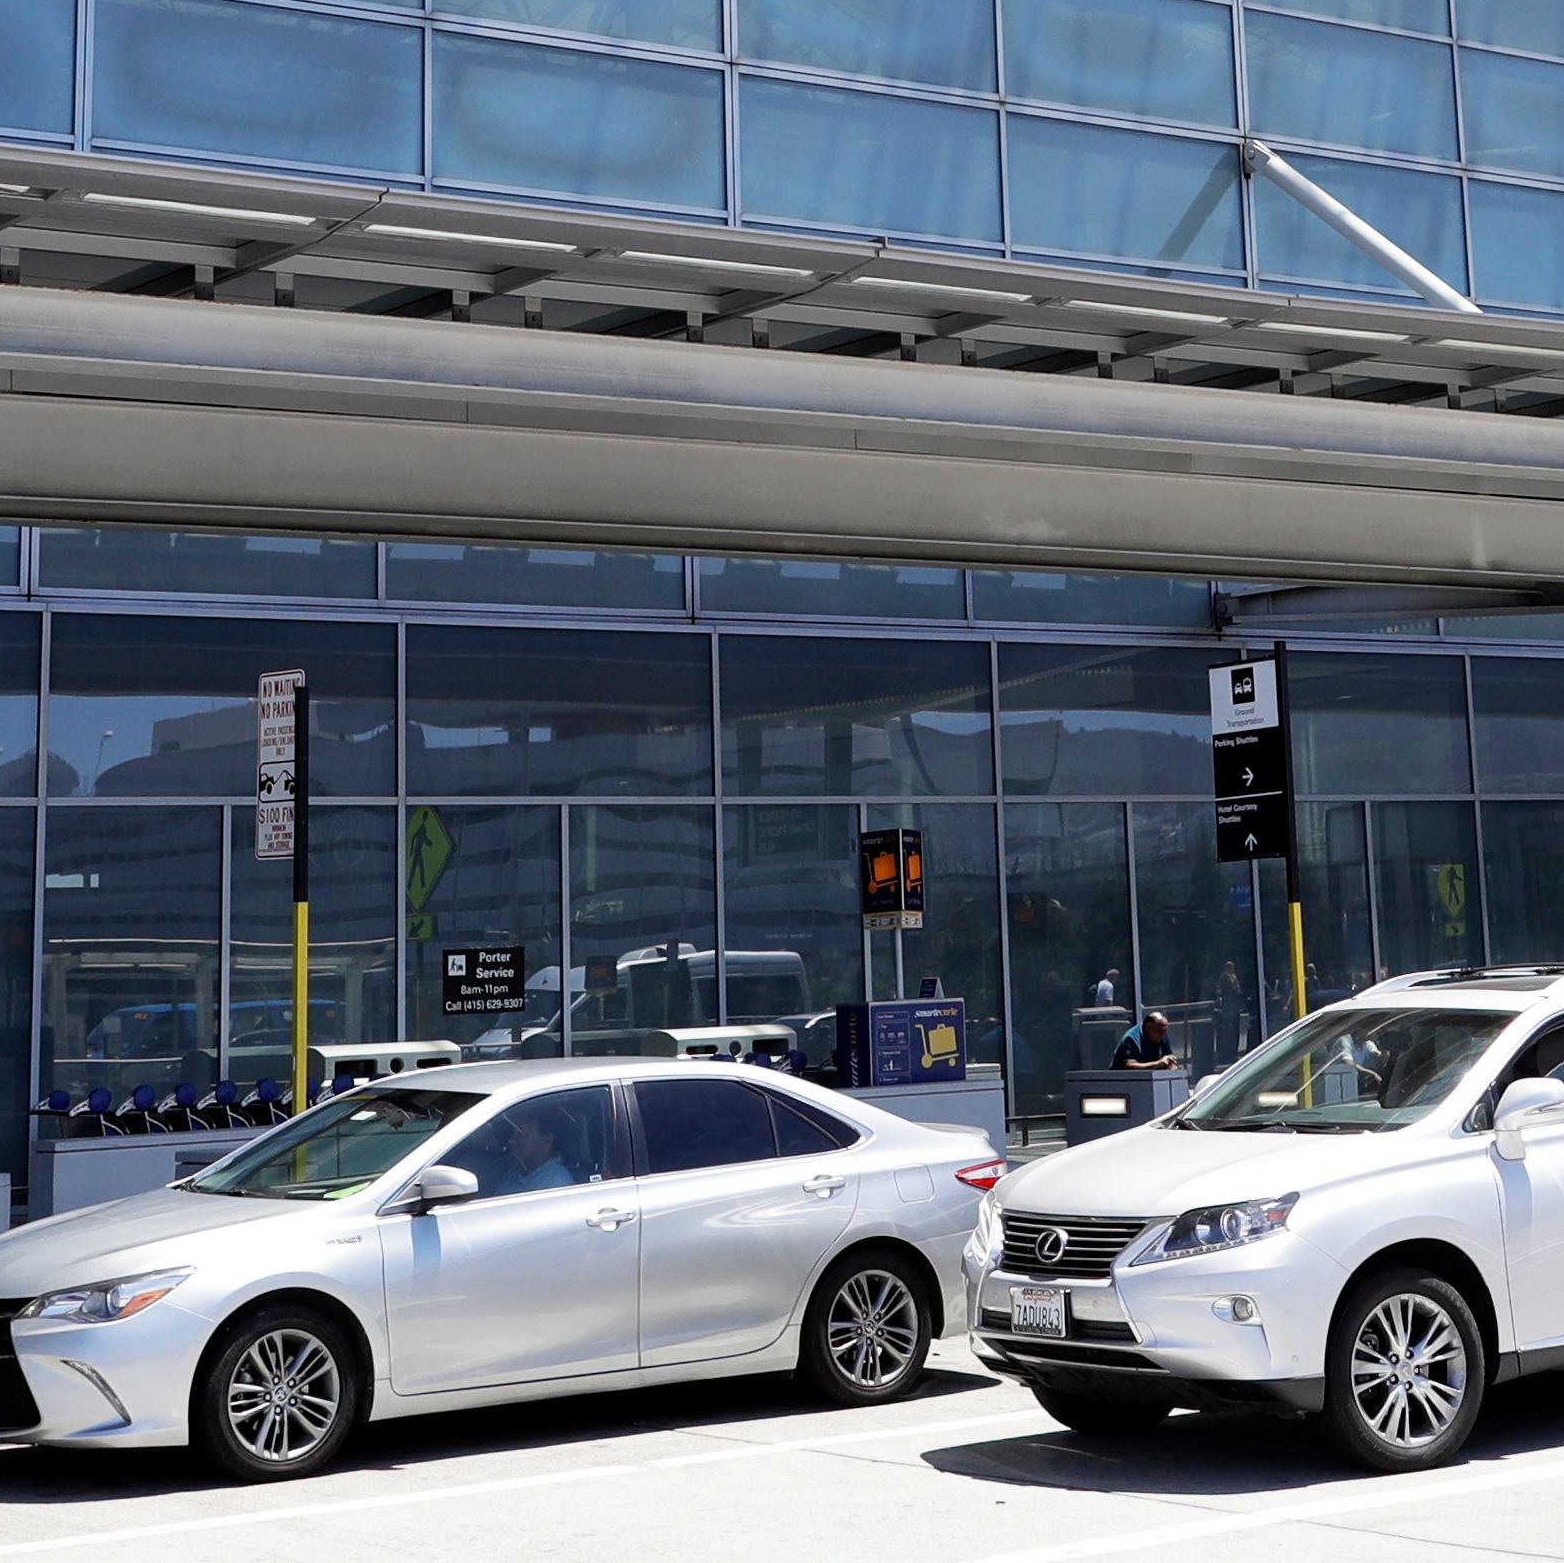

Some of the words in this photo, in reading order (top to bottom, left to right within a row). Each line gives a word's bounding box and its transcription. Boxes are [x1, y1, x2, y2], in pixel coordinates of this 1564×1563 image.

[272, 700, 295, 718] PARKIN
[1234, 707, 1255, 716] Ground
[282, 806, 295, 823] FIN
[479, 951, 511, 963] Porter
[476, 966, 515, 979] Service
[460, 984, 509, 995] 8am-11pm
[445, 1000, 462, 1011] Call
[463, 999, 485, 1012] (415)
[1016, 1304, 1060, 1330] 7ADU843
